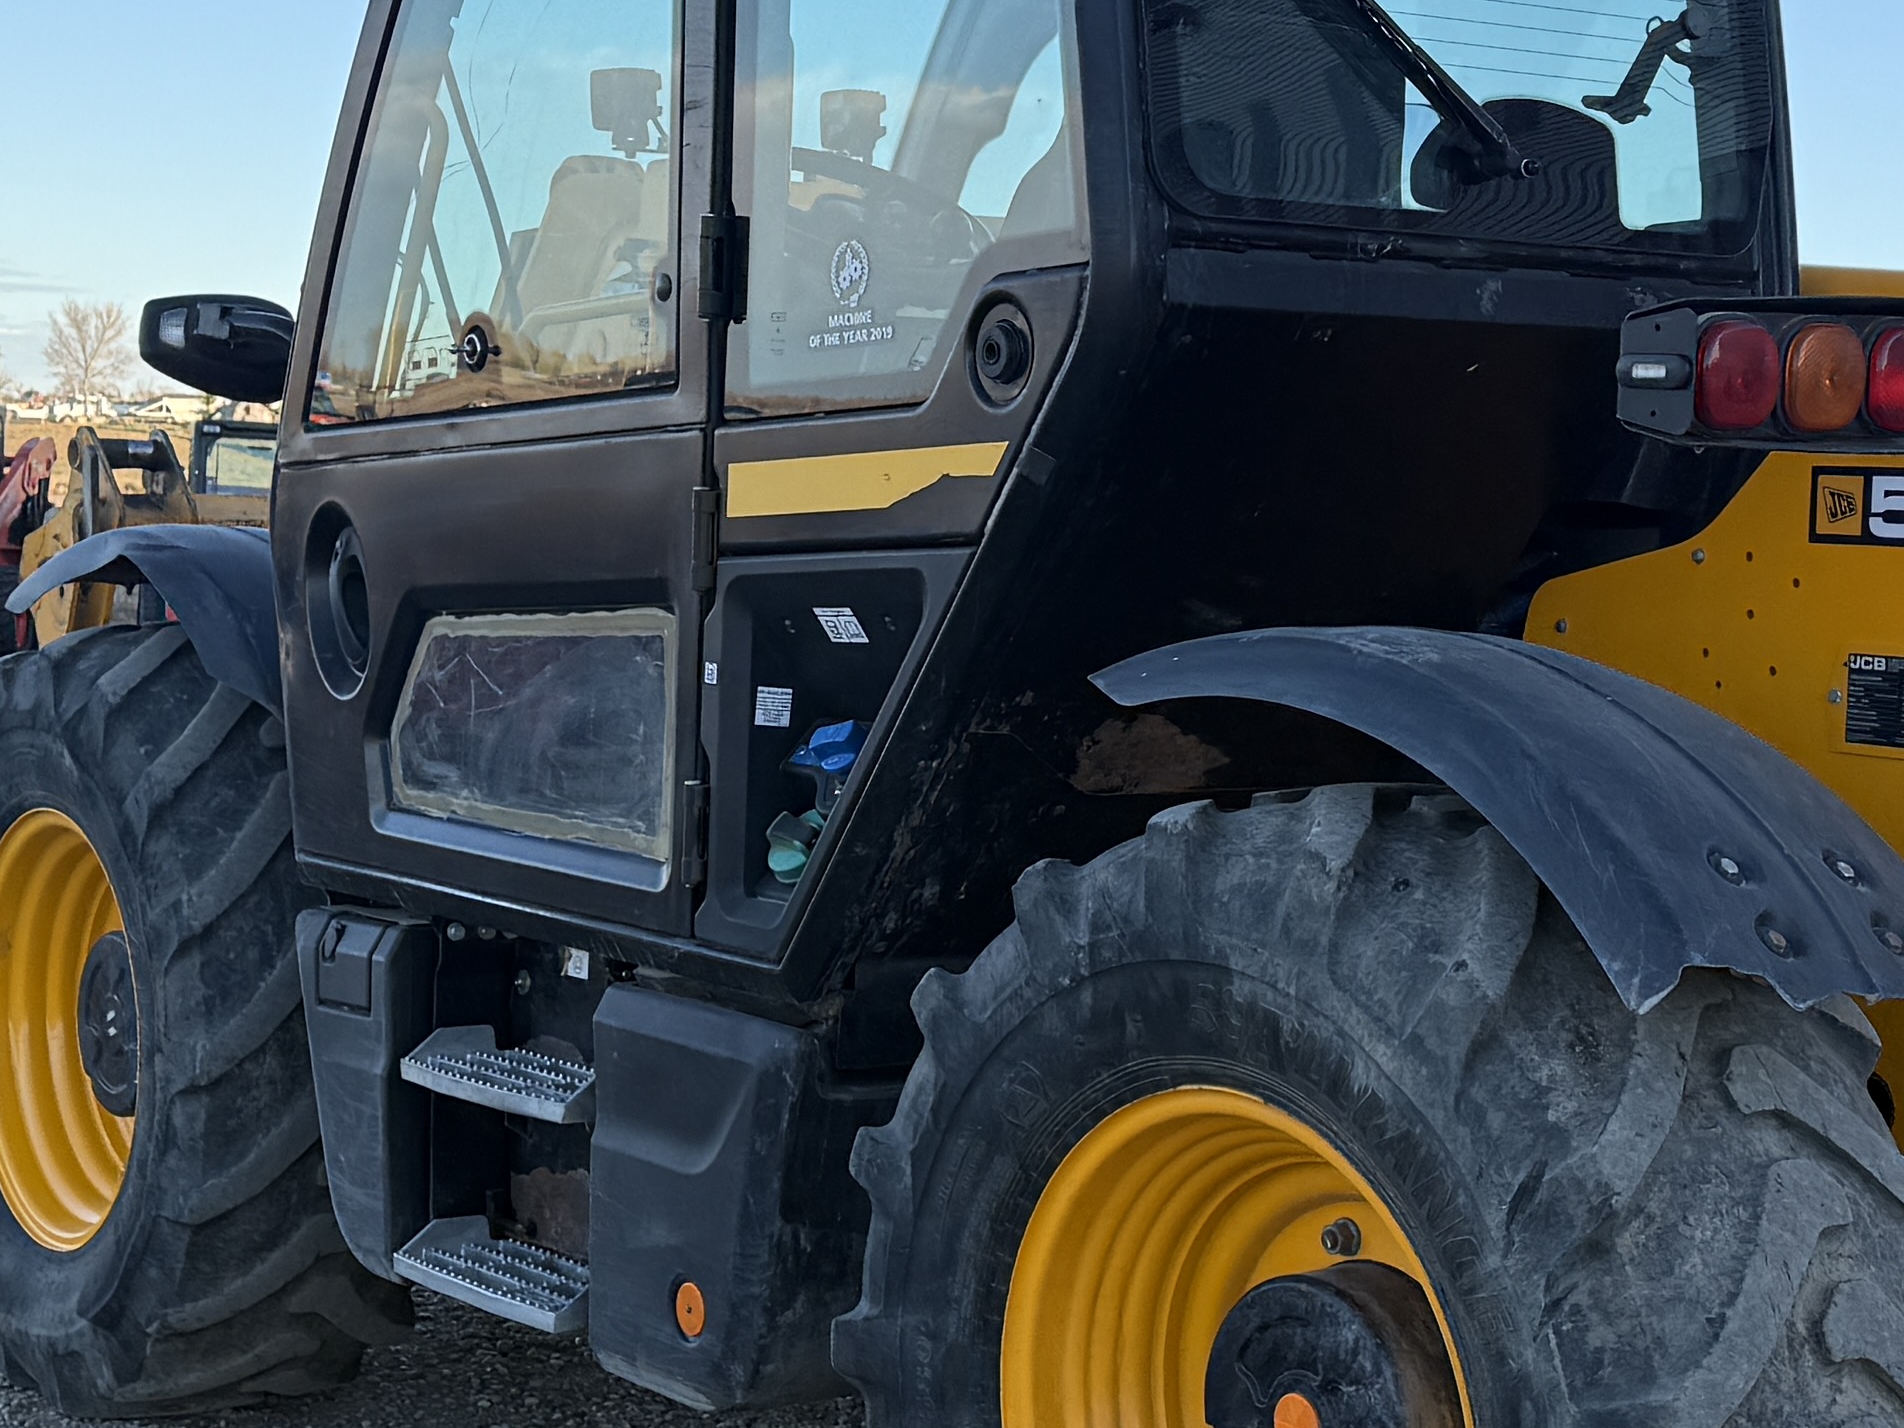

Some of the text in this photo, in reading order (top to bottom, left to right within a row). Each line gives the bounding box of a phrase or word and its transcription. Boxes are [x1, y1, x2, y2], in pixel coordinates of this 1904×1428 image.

[809, 326, 893, 348] OF THE YEAR 2019
[1850, 655, 1886, 671] JCB
